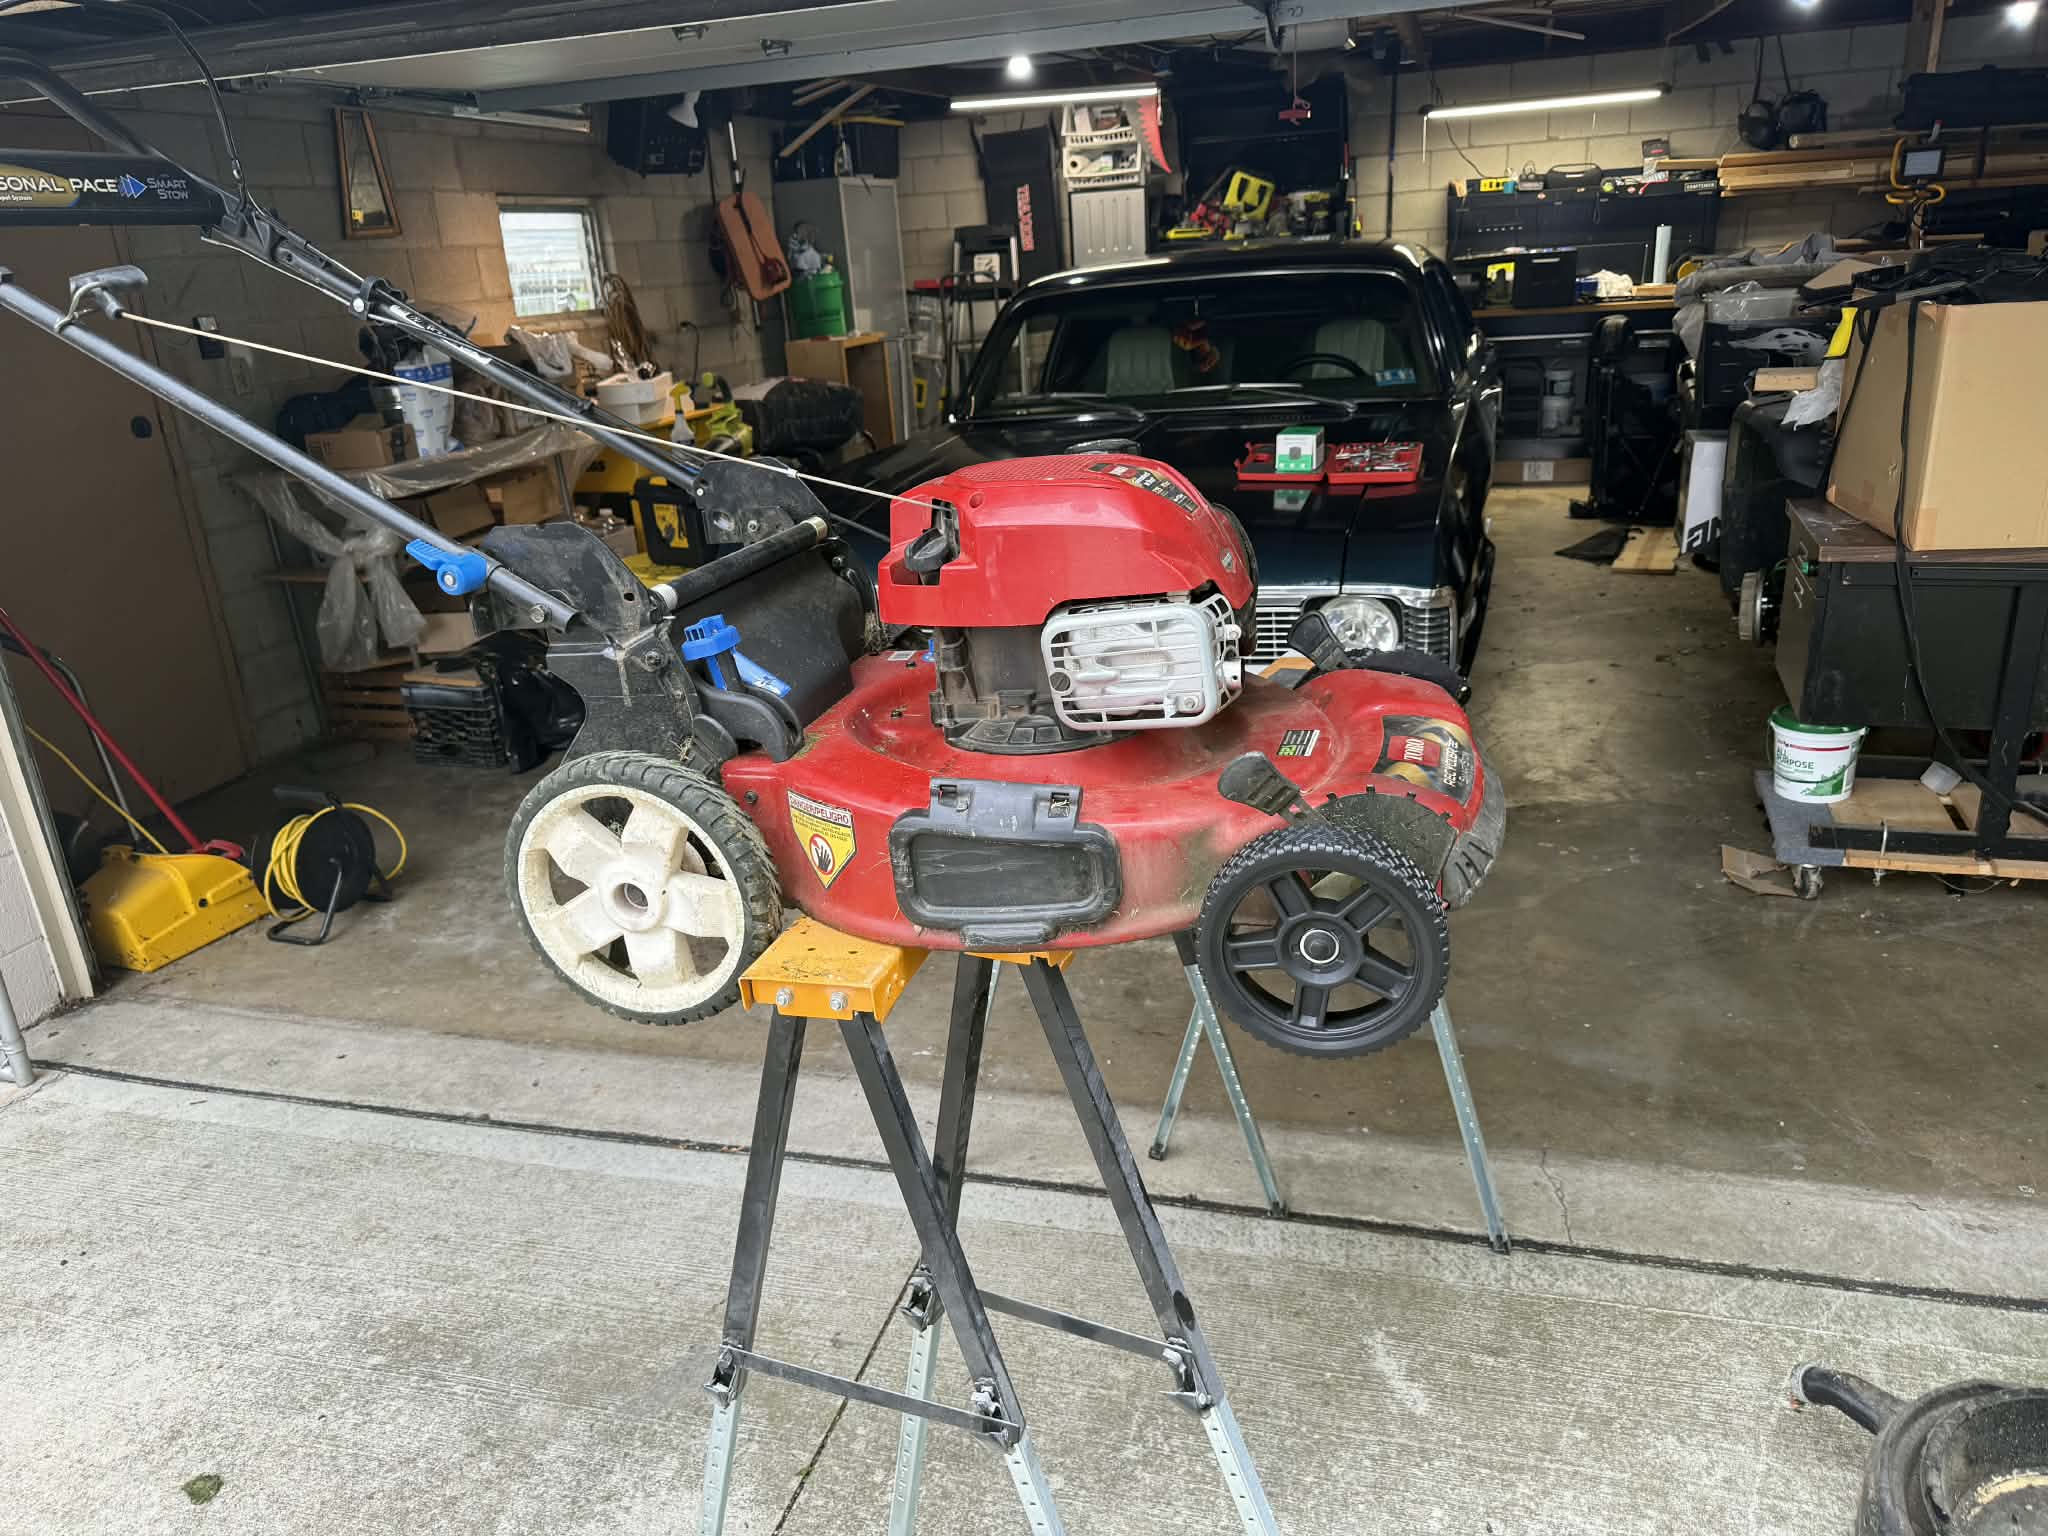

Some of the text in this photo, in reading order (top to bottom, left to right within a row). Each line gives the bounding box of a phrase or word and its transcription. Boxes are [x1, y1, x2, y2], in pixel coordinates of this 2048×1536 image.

[68, 178, 118, 192] PACE
[147, 177, 187, 189] SMART
[158, 189, 189, 200] STOW
[1403, 737, 1424, 761] TORO
